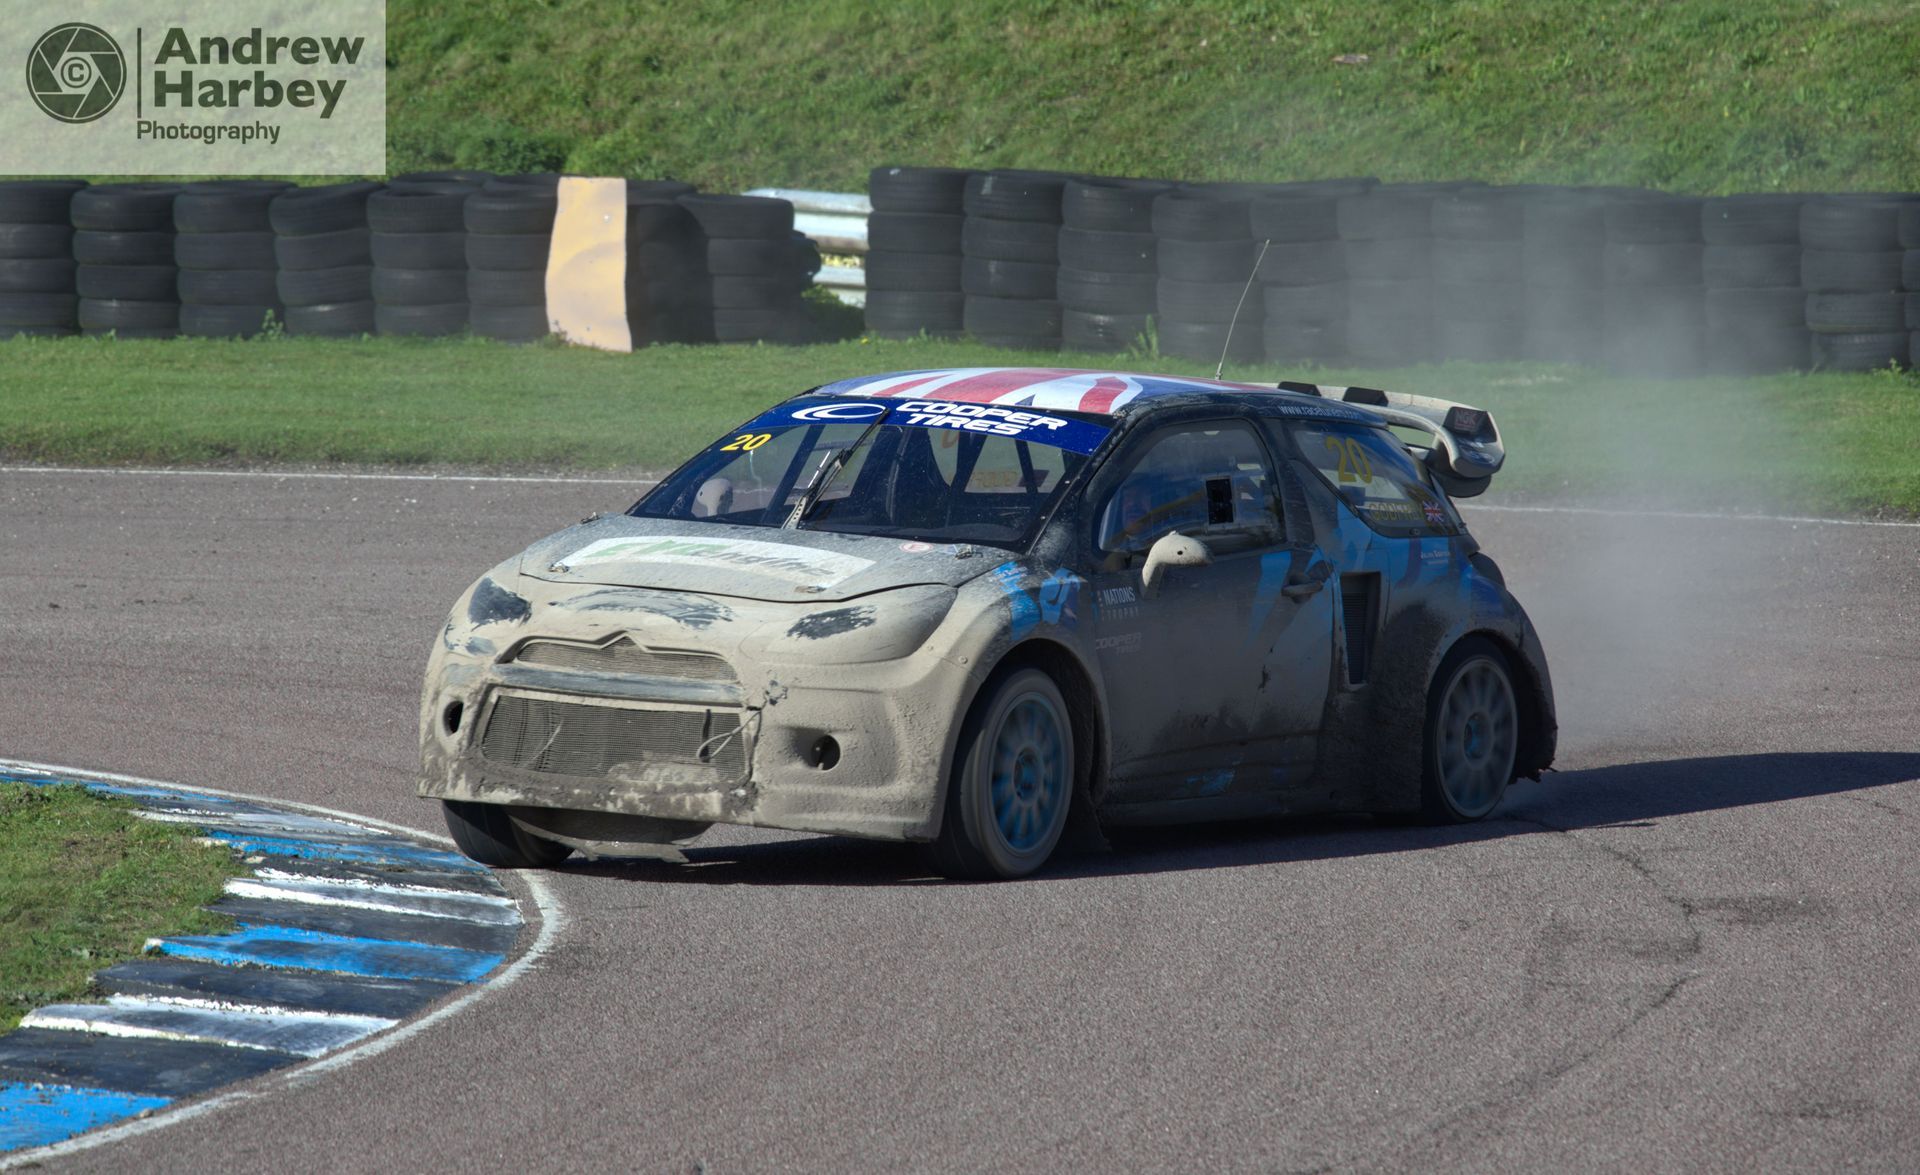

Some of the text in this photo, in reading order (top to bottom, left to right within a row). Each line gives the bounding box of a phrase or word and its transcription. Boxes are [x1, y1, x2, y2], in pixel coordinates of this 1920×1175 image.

[896, 402, 1068, 430] COOPER
[906, 413, 1029, 435] TIRES
[720, 434, 771, 450] 20
[1324, 436, 1372, 484] 20
[1103, 586, 1136, 606] NATIONS
